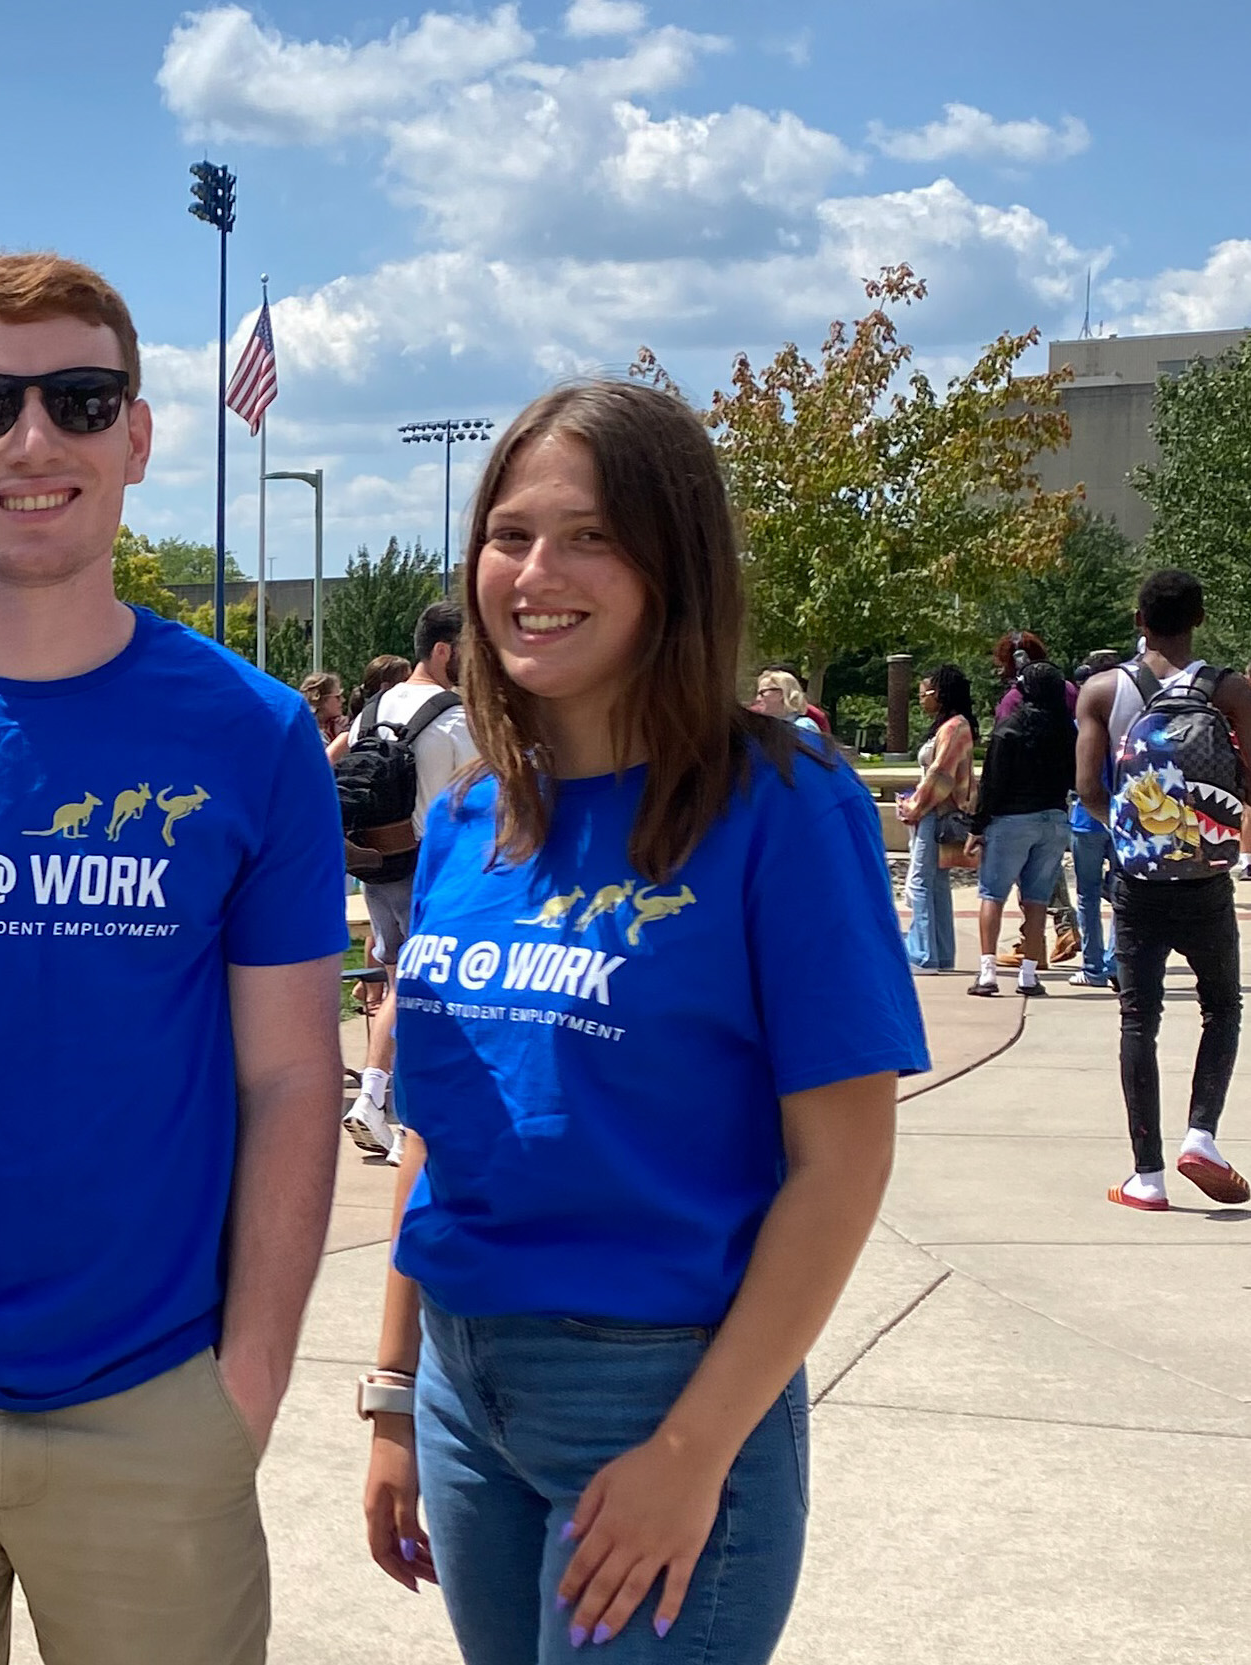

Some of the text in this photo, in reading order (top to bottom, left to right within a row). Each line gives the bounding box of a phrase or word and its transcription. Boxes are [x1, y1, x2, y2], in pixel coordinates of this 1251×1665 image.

[31, 855, 169, 907] WORK
[53, 923, 179, 936] EMPLOYMENT
[458, 941, 501, 990] @
[502, 942, 626, 1005] WORK
[447, 1003, 506, 1020] STUDENT
[510, 1008, 627, 1042] EMPLOYMENT
